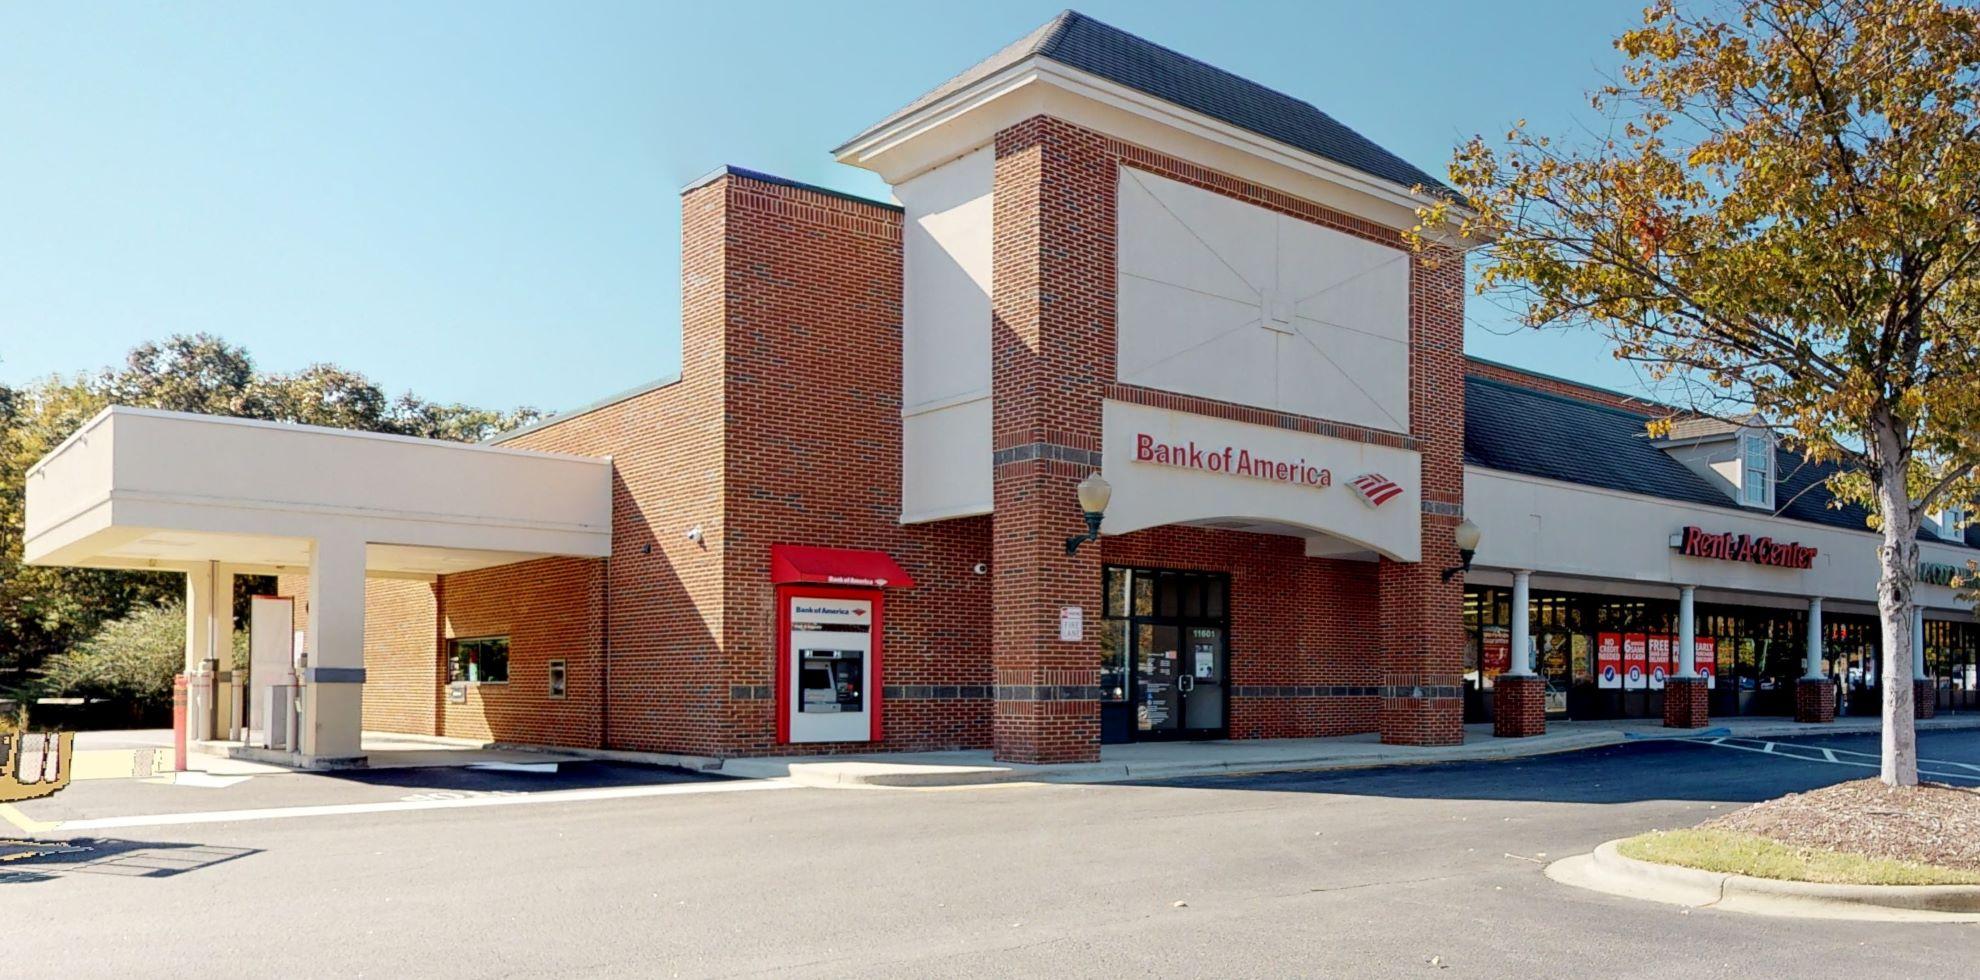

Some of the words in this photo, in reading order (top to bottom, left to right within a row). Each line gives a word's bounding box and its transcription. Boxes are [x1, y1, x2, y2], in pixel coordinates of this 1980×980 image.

[1137, 433, 1203, 469] Bank
[1207, 447, 1233, 472] of
[1237, 449, 1332, 487] America
[828, 575, 843, 583] Bank
[851, 577, 873, 585] America
[796, 606, 813, 614] Bank
[822, 607, 849, 615] America
[1624, 639, 1631, 652] 6
[1649, 639, 1669, 650] FREE
